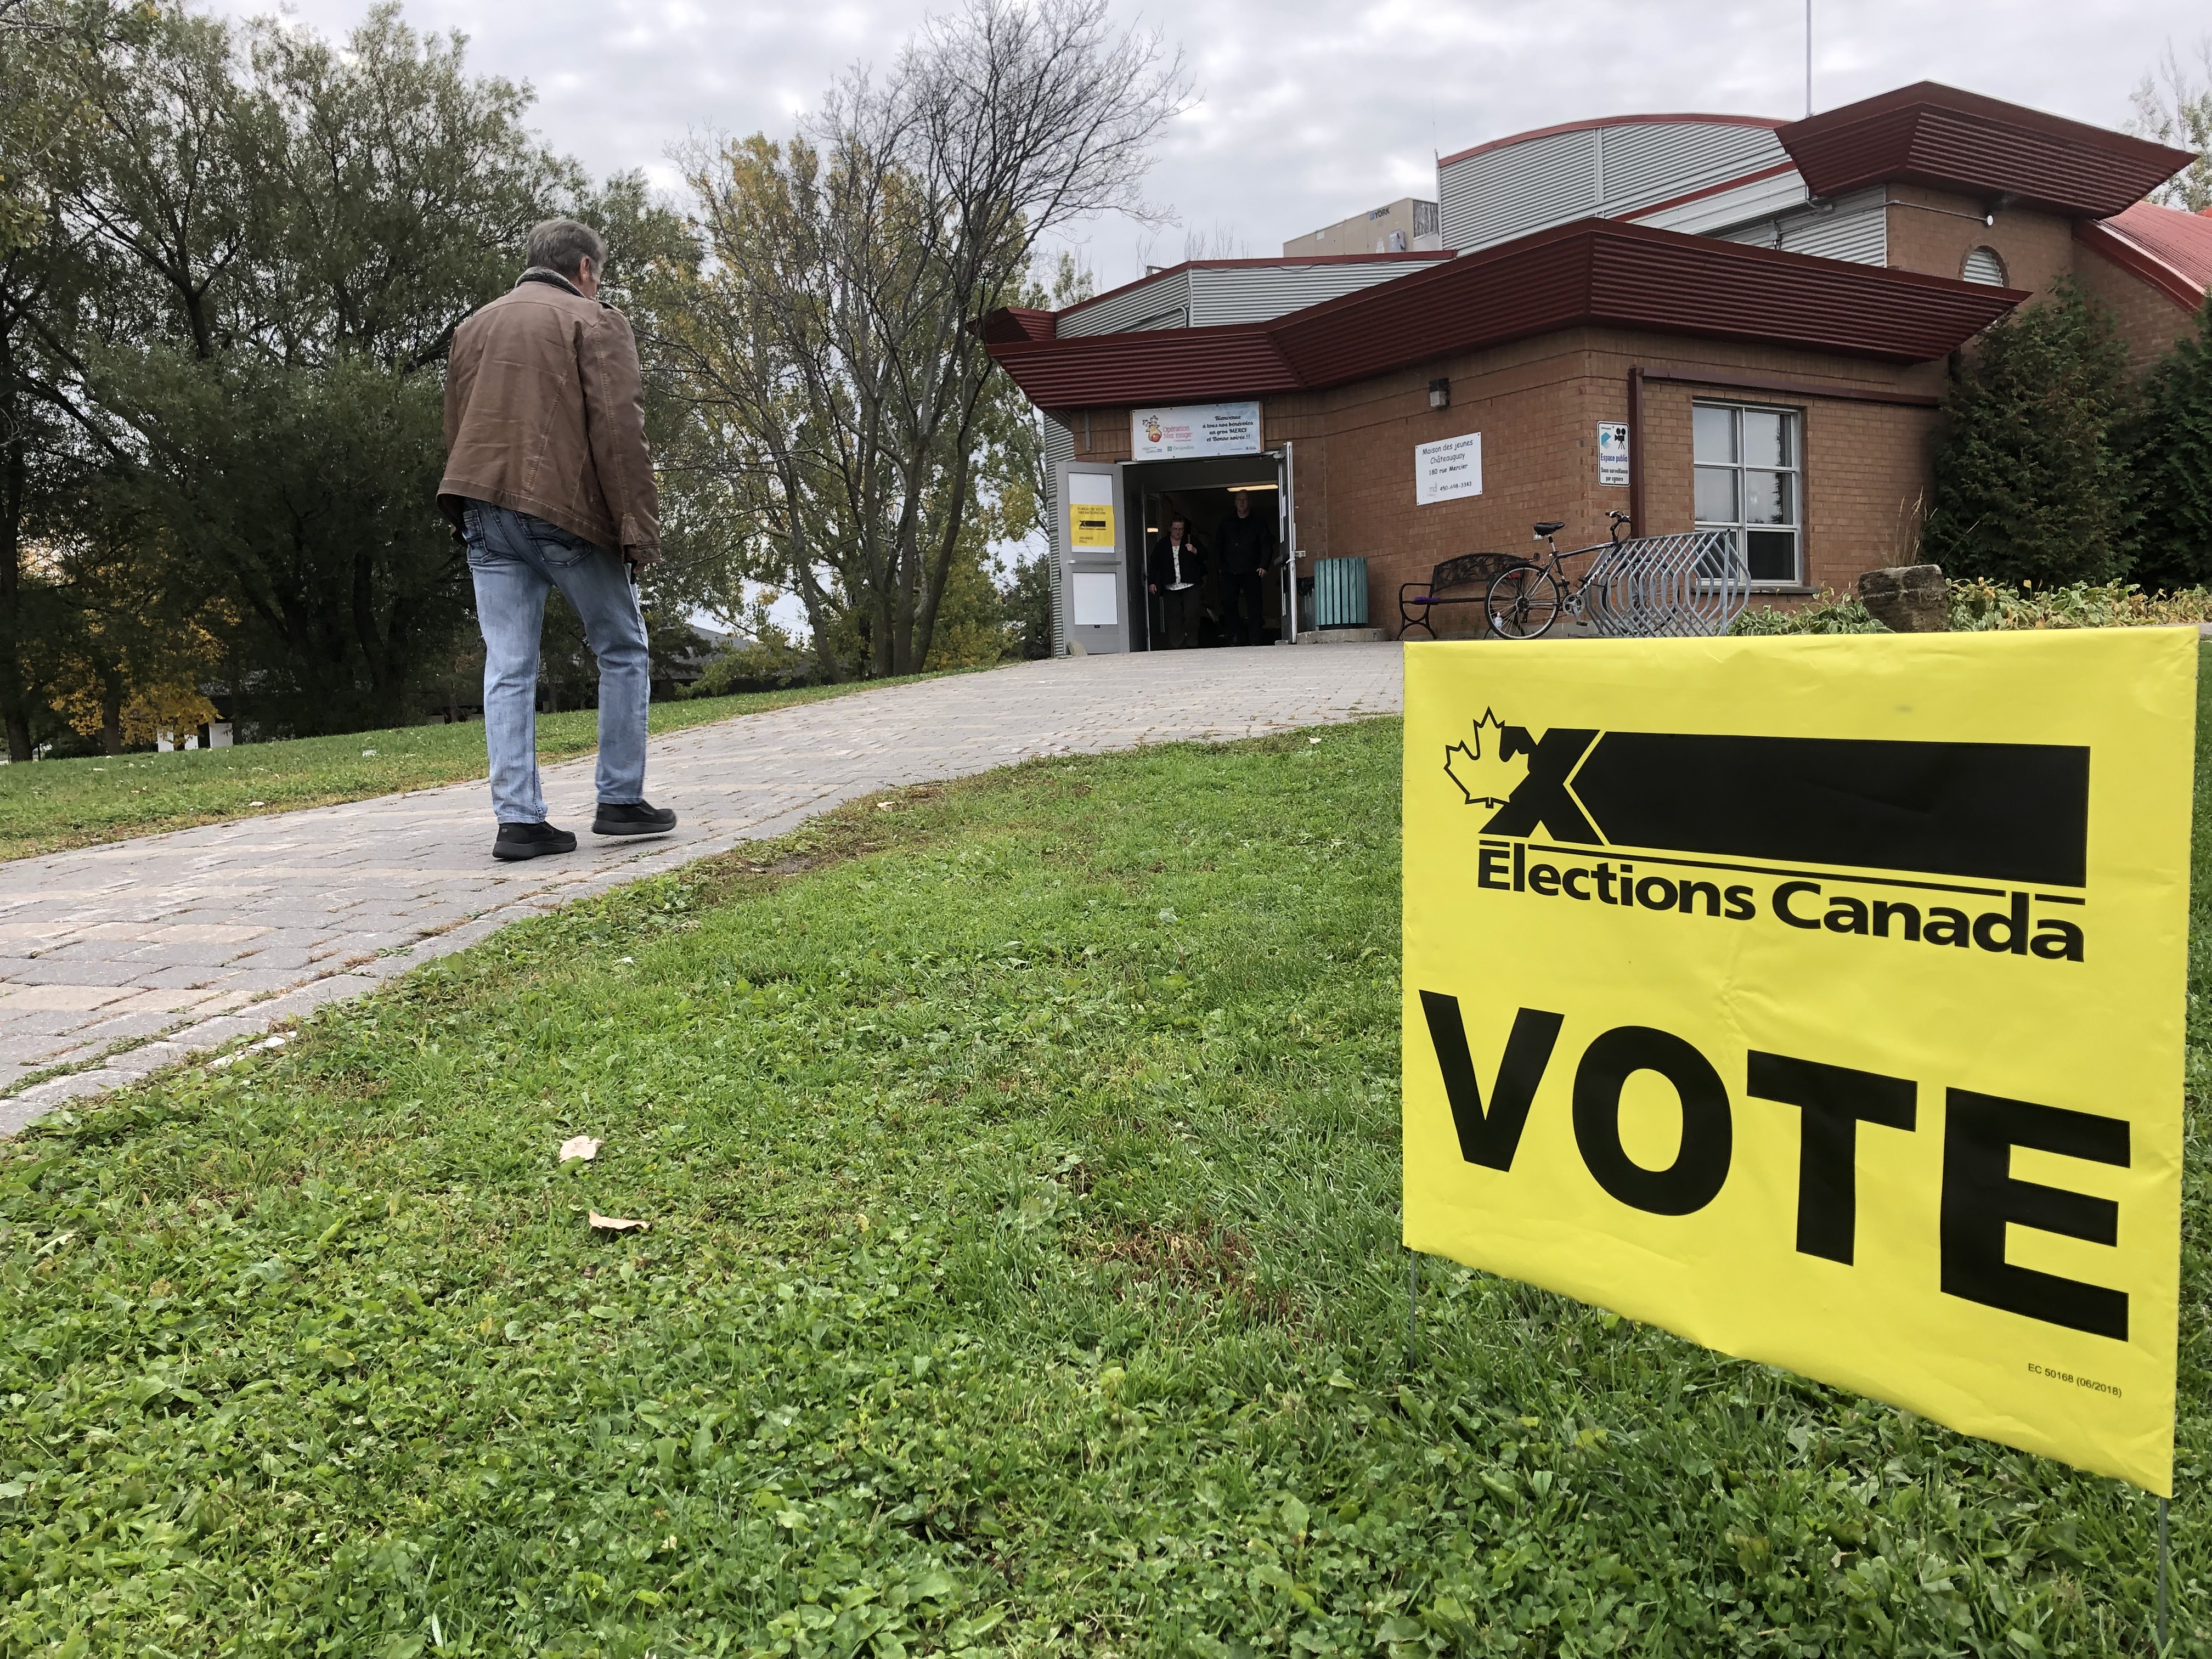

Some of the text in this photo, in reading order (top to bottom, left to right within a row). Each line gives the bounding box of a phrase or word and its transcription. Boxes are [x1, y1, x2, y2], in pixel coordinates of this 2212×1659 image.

[1375, 207, 1390, 218] YORK
[1422, 446, 1442, 455] Maison
[1454, 439, 1473, 450] jeunes
[1430, 453, 1465, 464] Châteauguay
[1601, 453, 1628, 463] Espace public
[1449, 464, 1468, 472] Mercier
[1478, 842, 2086, 963] Elections Canada
[1419, 989, 2131, 1342] VOTE
[2028, 1363, 2122, 1398] EC 50168 (06/2018)
